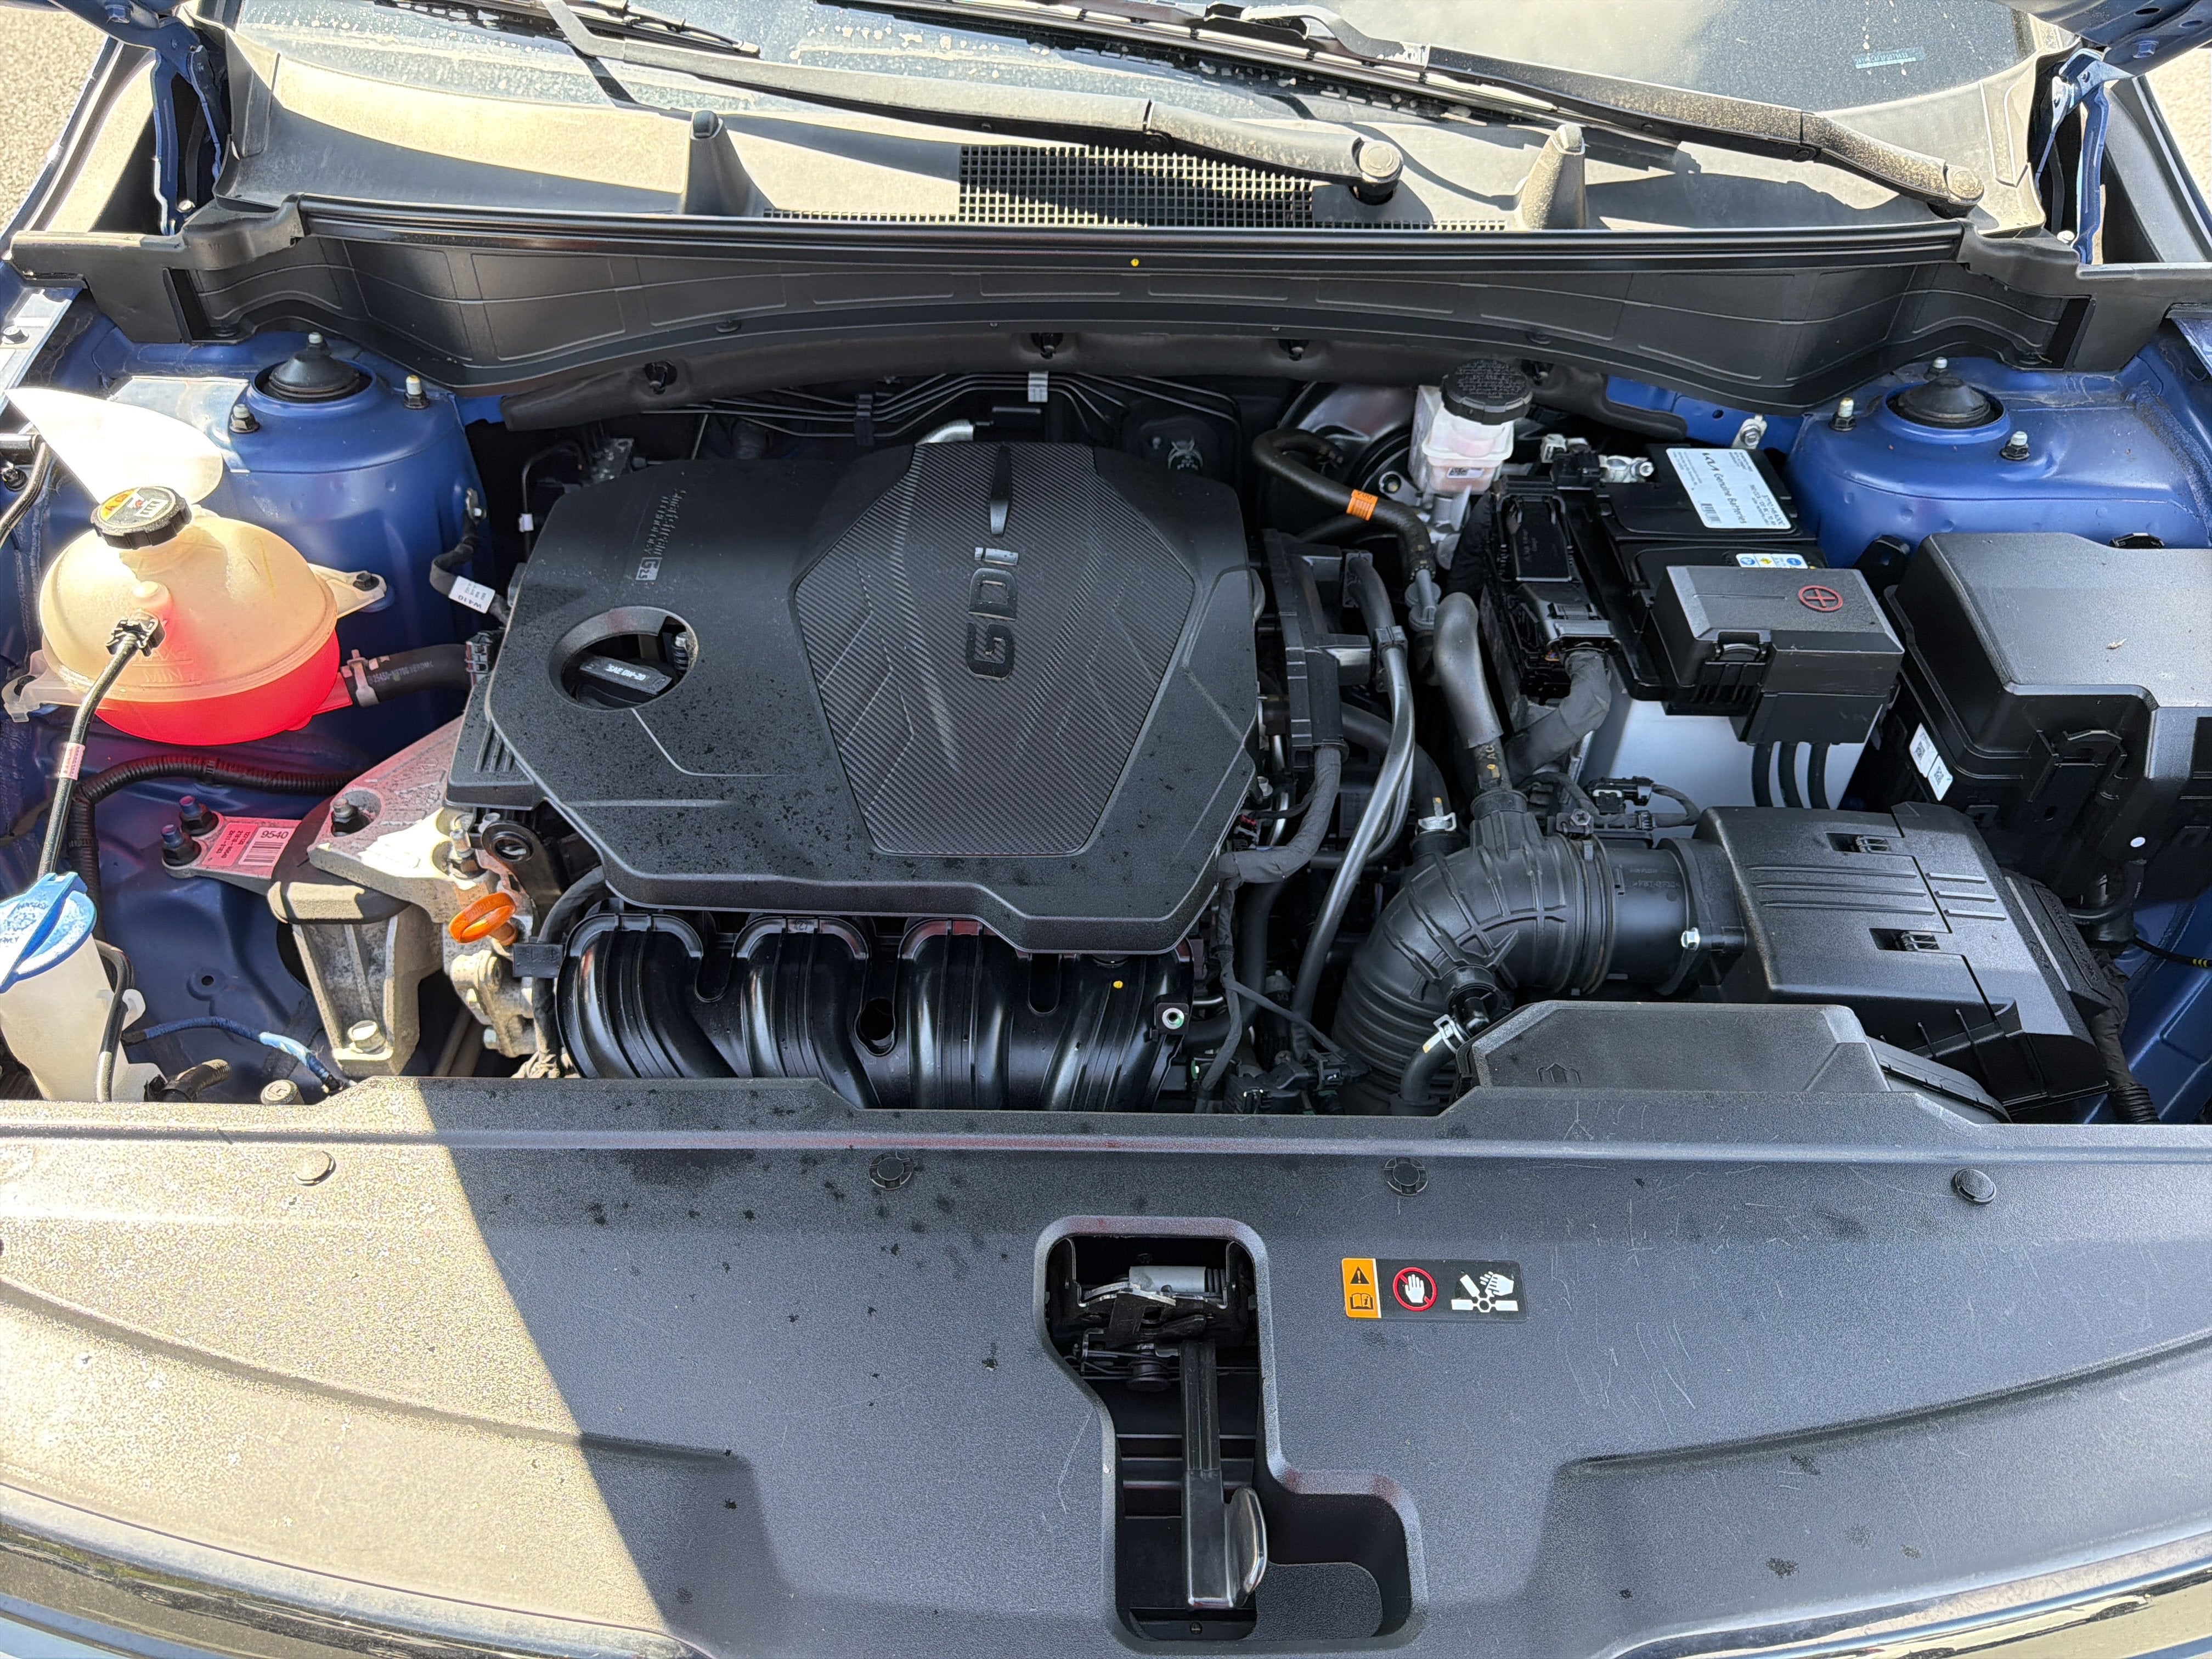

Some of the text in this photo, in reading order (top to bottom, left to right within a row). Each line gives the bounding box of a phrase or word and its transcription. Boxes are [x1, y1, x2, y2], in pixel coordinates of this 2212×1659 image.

[1714, 473, 1733, 497] Genuine
[1727, 497, 1747, 523] Batteries
[605, 663, 647, 681] SAE 0W-20
[260, 830, 289, 839] 9540
